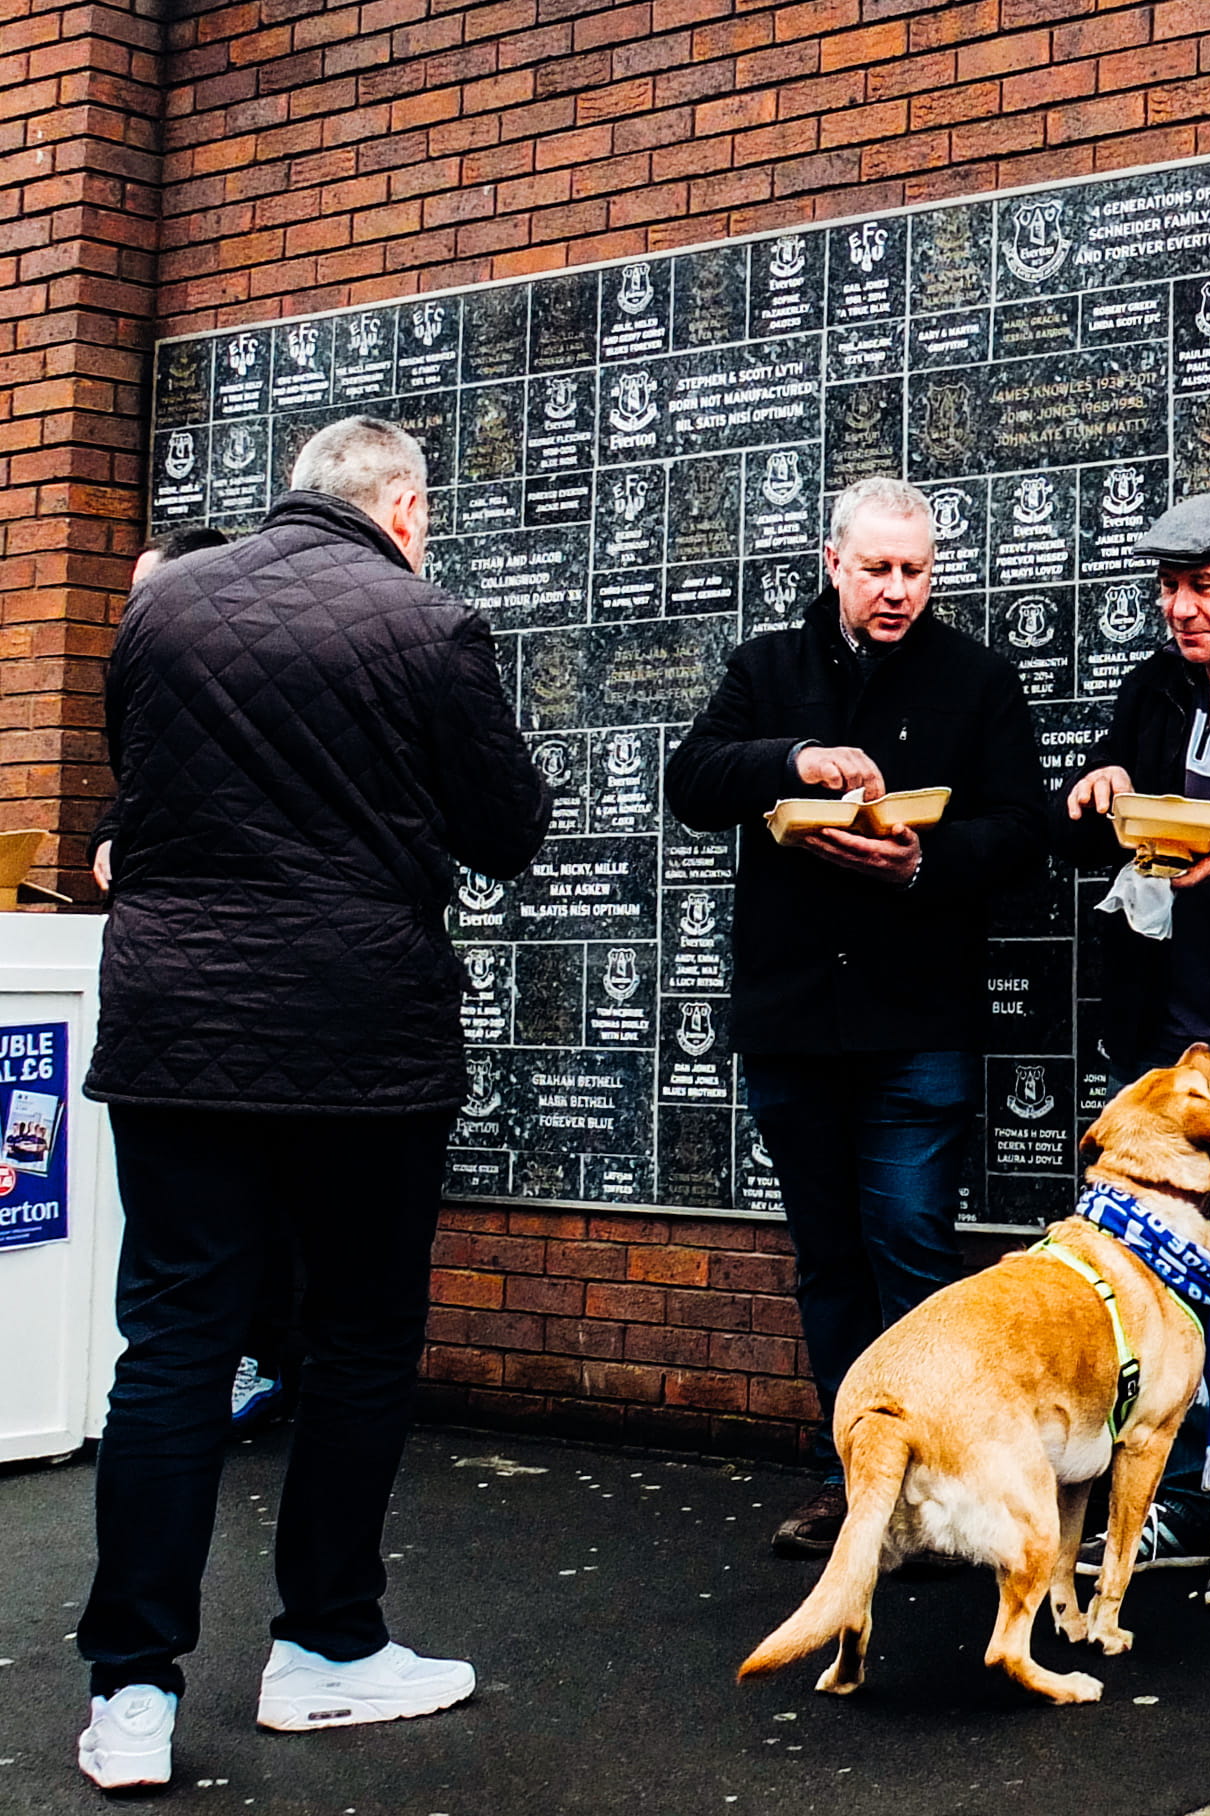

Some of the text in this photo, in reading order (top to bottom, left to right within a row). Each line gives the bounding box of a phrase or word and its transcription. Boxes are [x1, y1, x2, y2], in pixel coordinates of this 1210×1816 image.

[1103, 191, 1192, 216] GENERATIONS
[1089, 218, 1161, 240] SCHNEIDER
[1075, 250, 1102, 265] AND
[1105, 241, 1164, 259] FOREVER
[1116, 316, 1142, 327] SCOTT
[677, 373, 727, 391] STEPHEN
[738, 366, 773, 382] SCOTT
[669, 382, 812, 412] BORN NOT MANUFACTURED
[676, 419, 693, 432] NIL
[696, 414, 726, 429] SATIS
[752, 403, 803, 420] OPTIMUM
[609, 433, 656, 449] Everton
[1095, 533, 1125, 545] JAMES
[471, 552, 562, 570] ETHAN AND JACOB
[1082, 561, 1121, 572] EVERTON
[762, 565, 799, 589] EFC
[1042, 730, 1092, 745] GEORGE
[540, 905, 568, 916] SATIS
[593, 905, 640, 915] OPTIMUM
[988, 979, 1029, 991] USHER
[0, 1058, 53, 1083] L £6
[1084, 1074, 1106, 1082] JOHN
[1089, 1087, 1106, 1095] AND
[539, 1115, 614, 1129] FOREVER BLUE
[994, 1128, 1066, 1138] THOMAS H DOYLE
[998, 1154, 1025, 1163] LAURA
[1036, 1155, 1063, 1165] DOYLE
